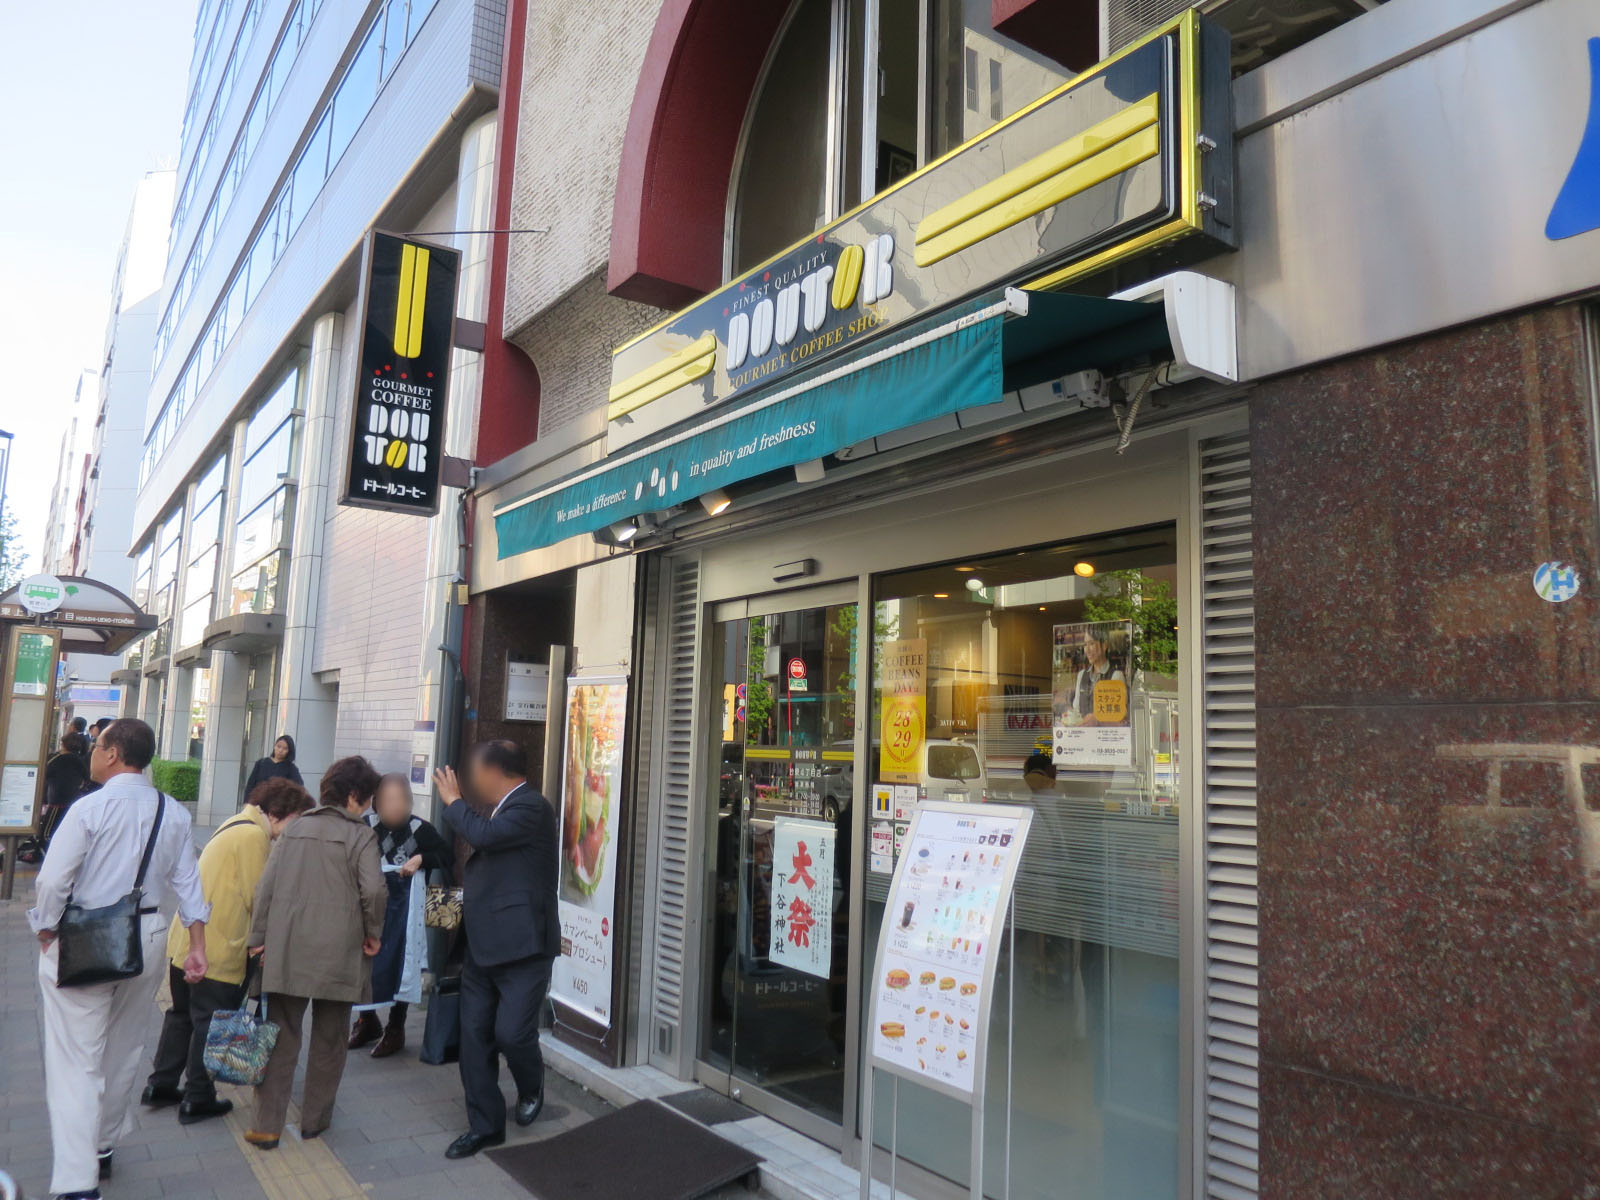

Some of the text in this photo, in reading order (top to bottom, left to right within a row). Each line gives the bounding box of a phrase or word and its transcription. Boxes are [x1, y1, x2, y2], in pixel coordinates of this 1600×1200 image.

[732, 250, 828, 313] FINEST QUALITY
[727, 233, 895, 371] DOUTOR
[790, 326, 844, 363] COFFEE
[848, 306, 889, 338] SHOP
[372, 378, 433, 397] GOURMET
[371, 389, 432, 411] COFFEE
[690, 420, 817, 477] in quality and freshness
[363, 479, 427, 499] ドトールコーヒー
[557, 489, 627, 523] We make a difference
[885, 655, 924, 668] COFFEE
[888, 668, 921, 680] BEANS
[893, 710, 912, 728] 28
[893, 730, 912, 748] 29
[819, 838, 827, 860] 五月
[787, 840, 817, 949] 大祭
[774, 873, 787, 955] 下谷神社
[572, 943, 608, 970] プロシュート
[573, 976, 588, 995] ¥450
[755, 980, 820, 996] ドトールコーヒー
